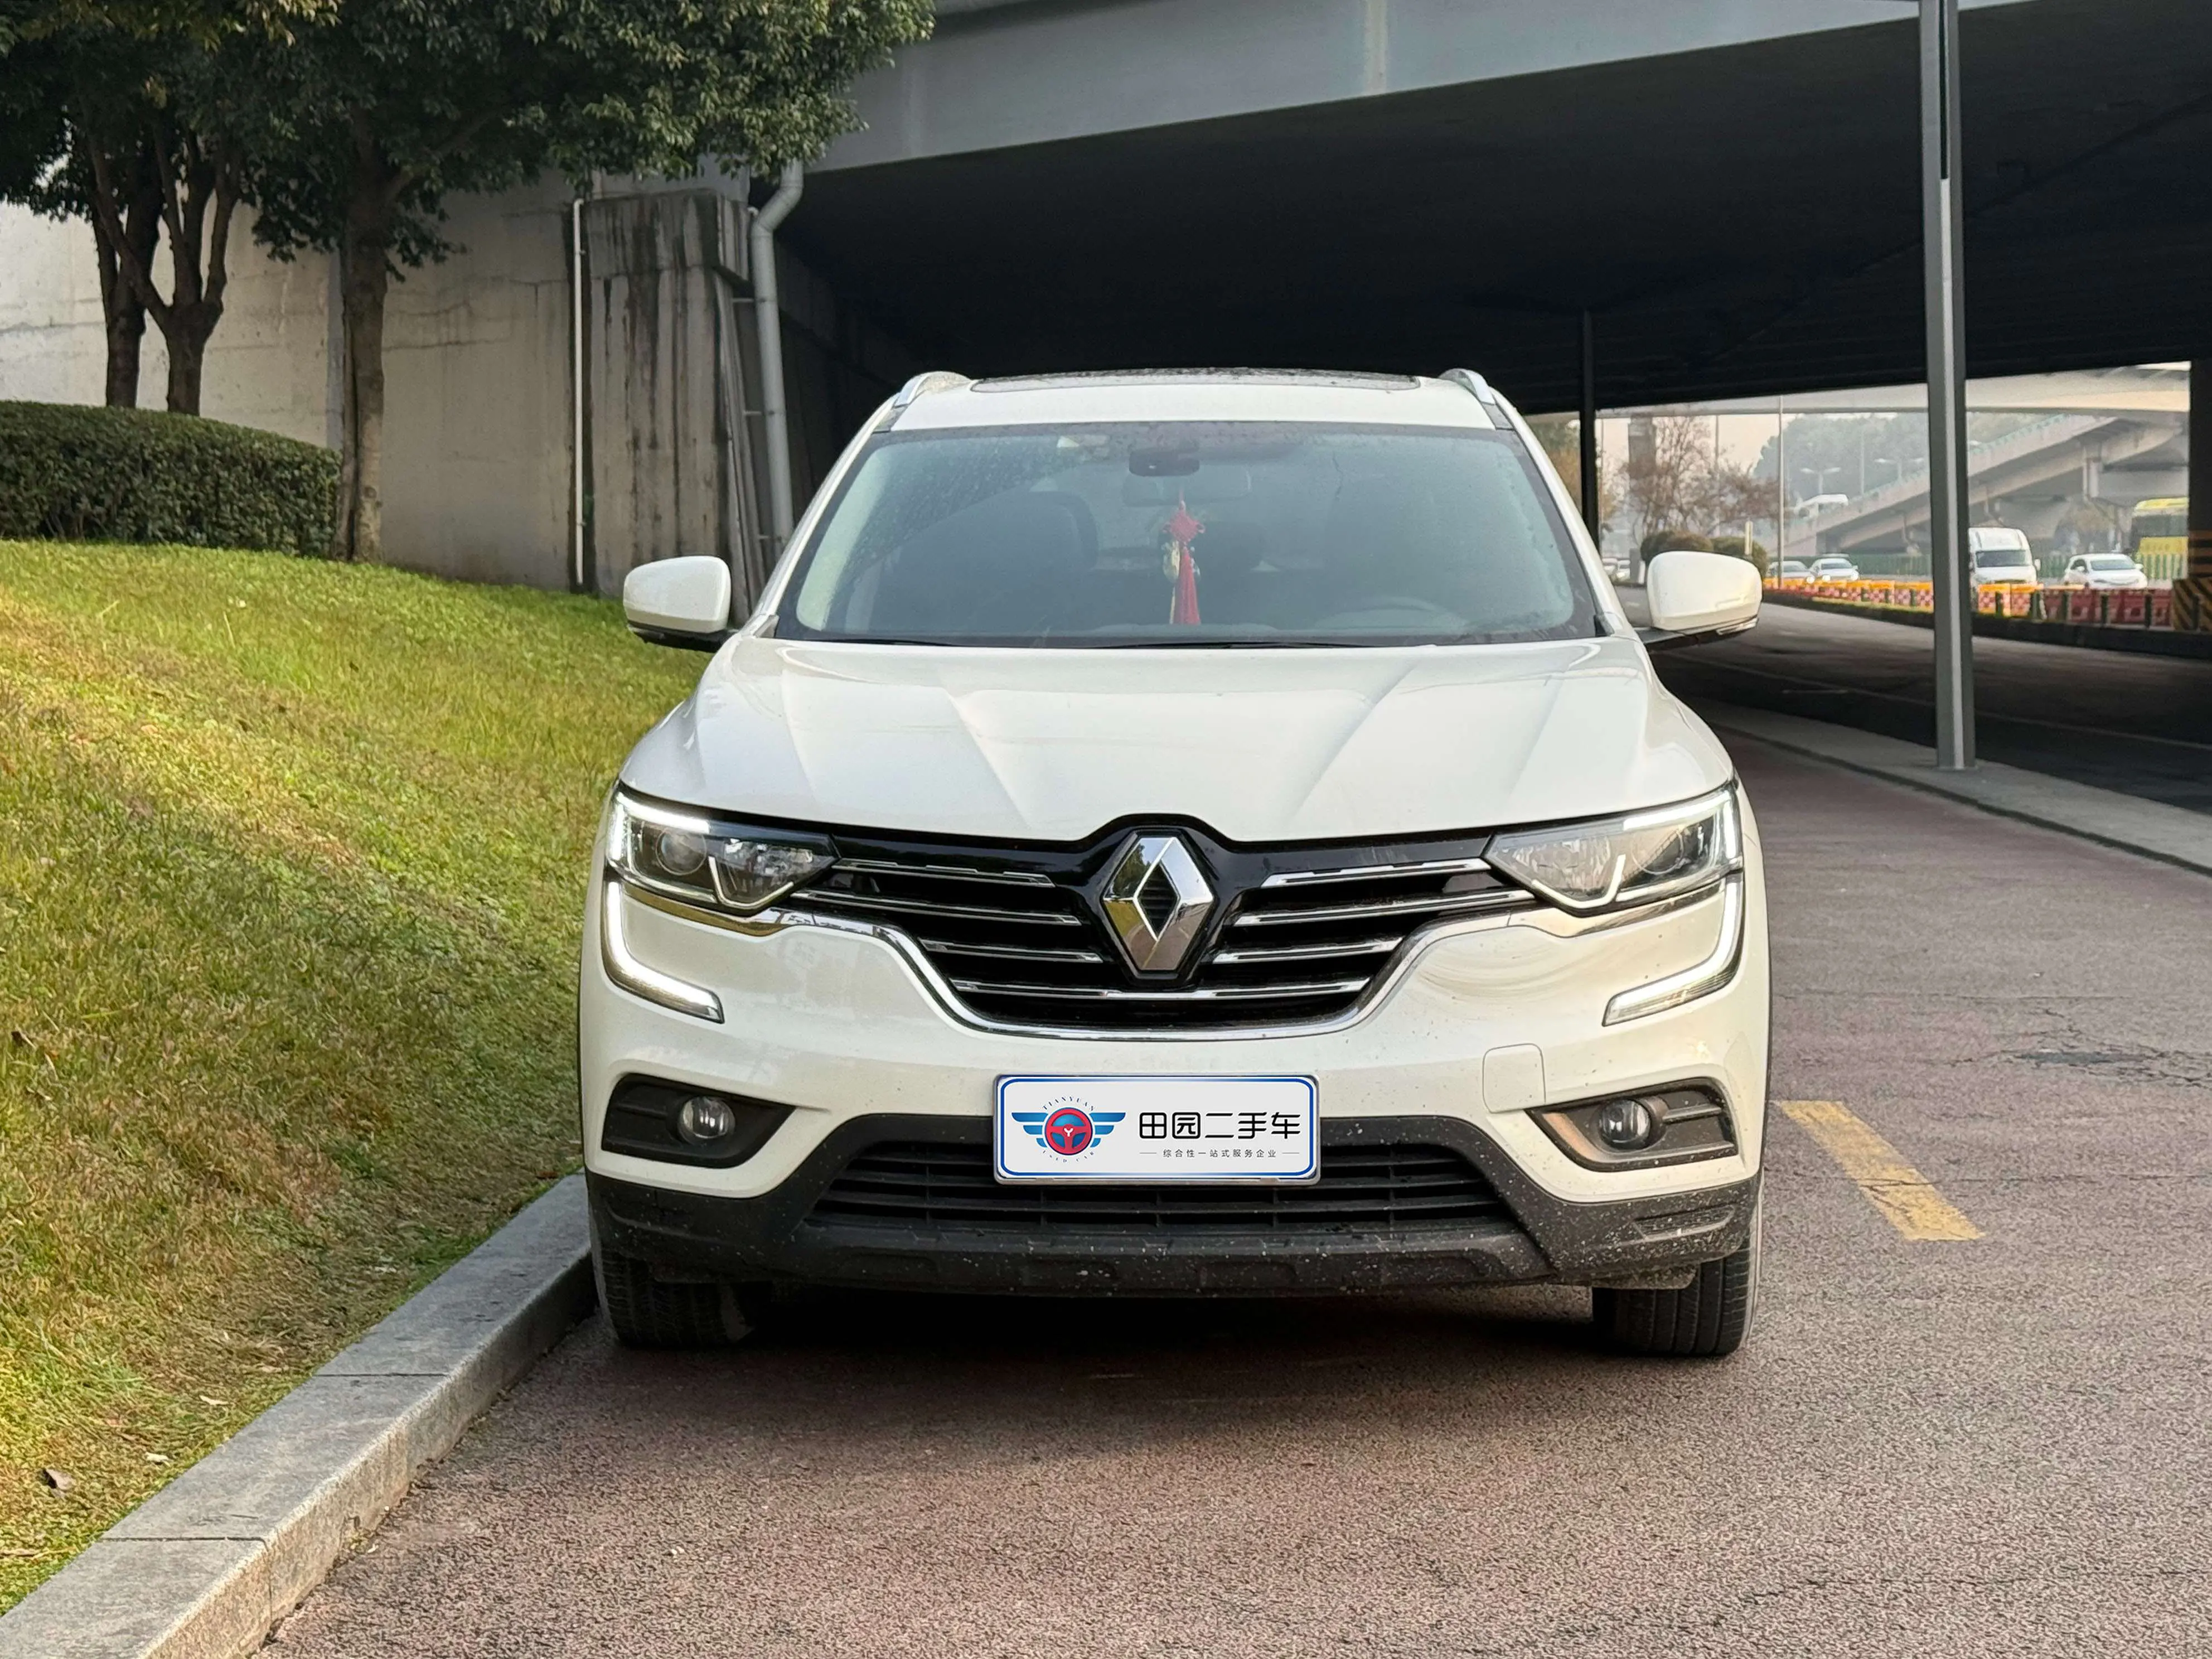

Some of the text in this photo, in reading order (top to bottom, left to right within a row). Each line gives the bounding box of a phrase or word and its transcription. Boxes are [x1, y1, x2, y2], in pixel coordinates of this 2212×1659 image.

[1139, 1111, 1301, 1139] 田园二手车
[1163, 1149, 1276, 1158] 综合性一站式服务企业
